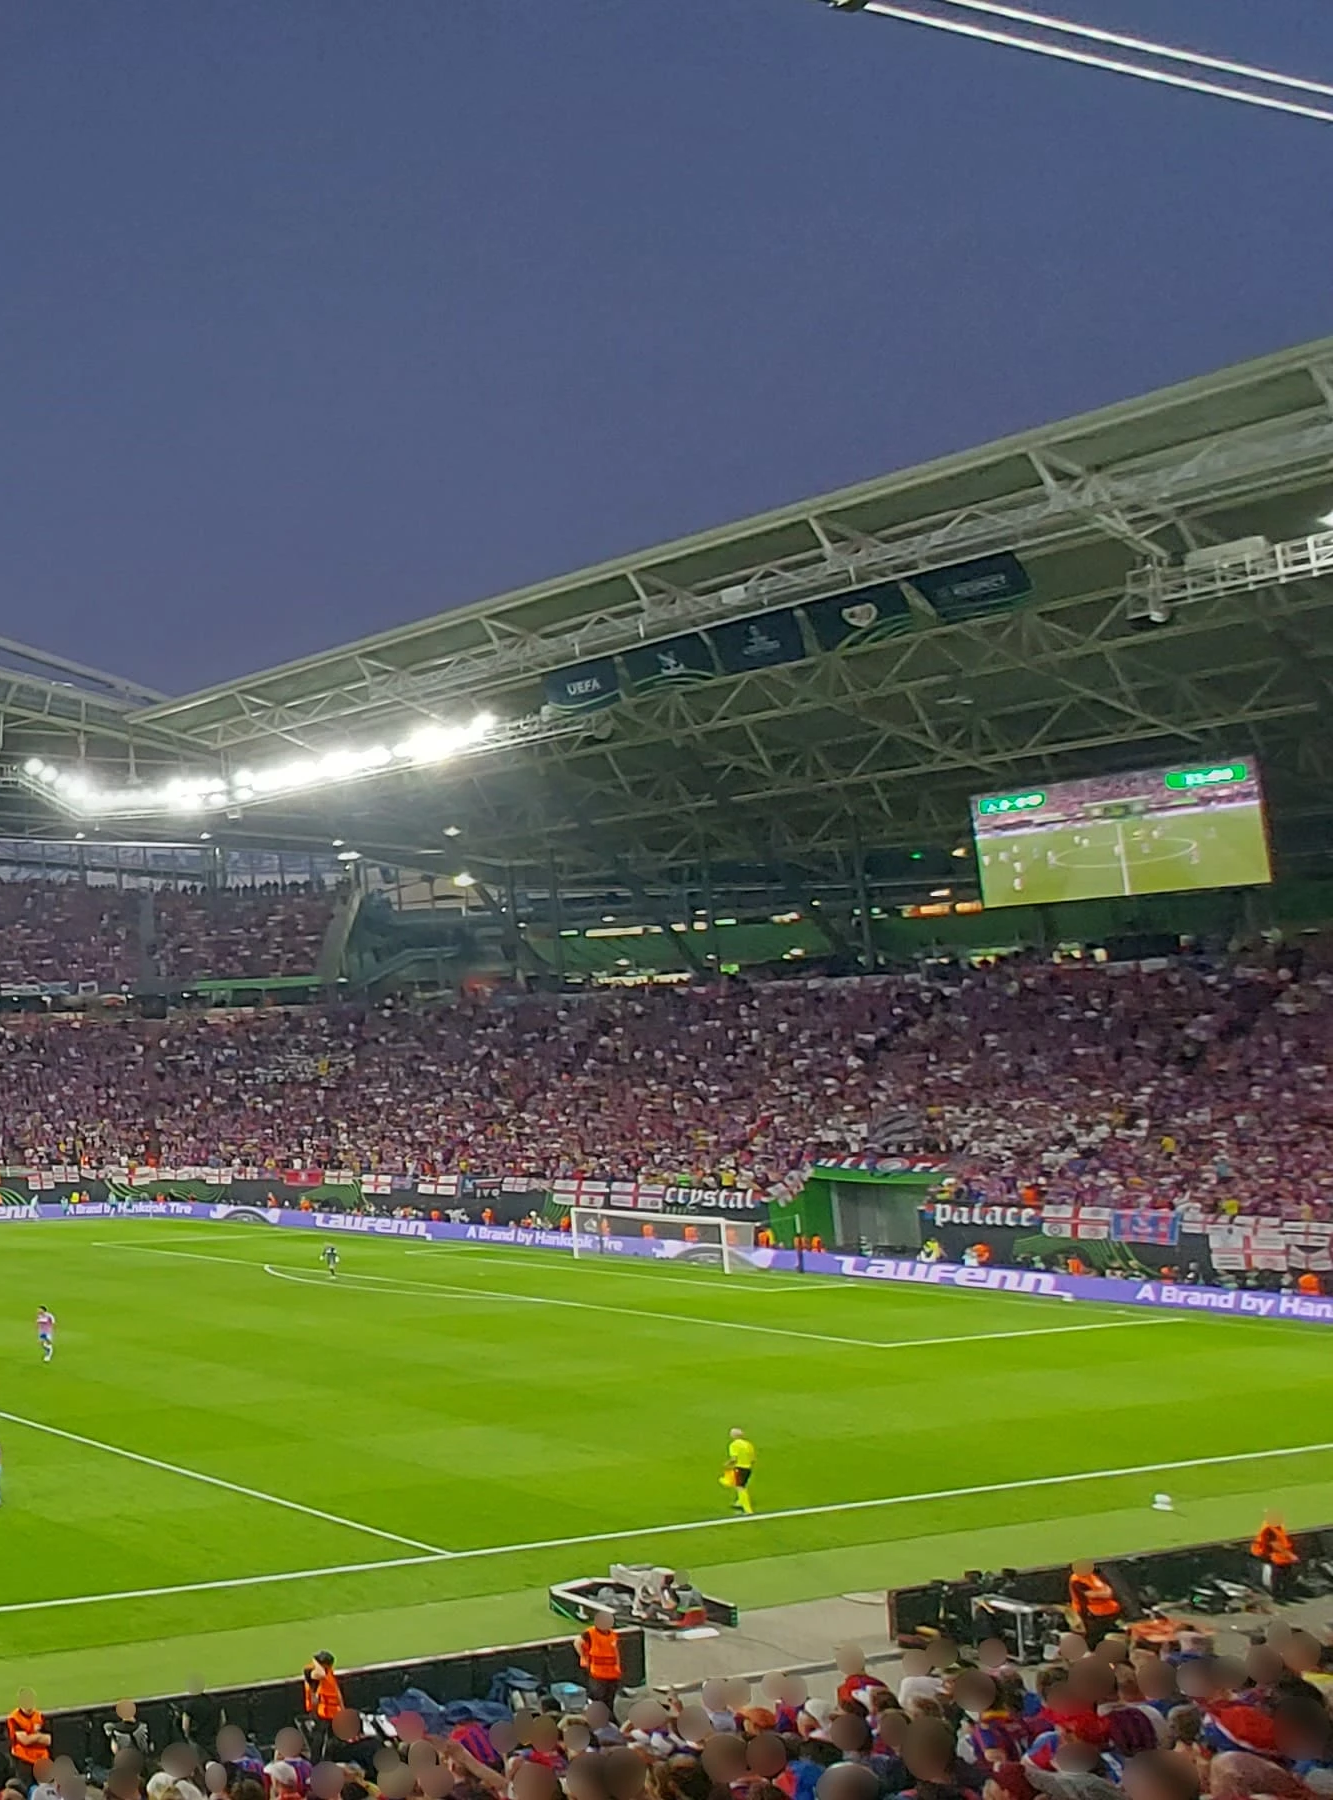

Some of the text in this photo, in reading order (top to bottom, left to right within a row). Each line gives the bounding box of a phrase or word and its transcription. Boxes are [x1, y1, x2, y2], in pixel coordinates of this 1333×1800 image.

[566, 677, 601, 696] UEFA
[118, 1202, 166, 1214] Hnkook
[479, 1226, 514, 1242] Brand
[517, 1229, 533, 1245] by
[1135, 1283, 1155, 1301] A
[1159, 1285, 1235, 1309] Brand
[1240, 1291, 1275, 1316] by
